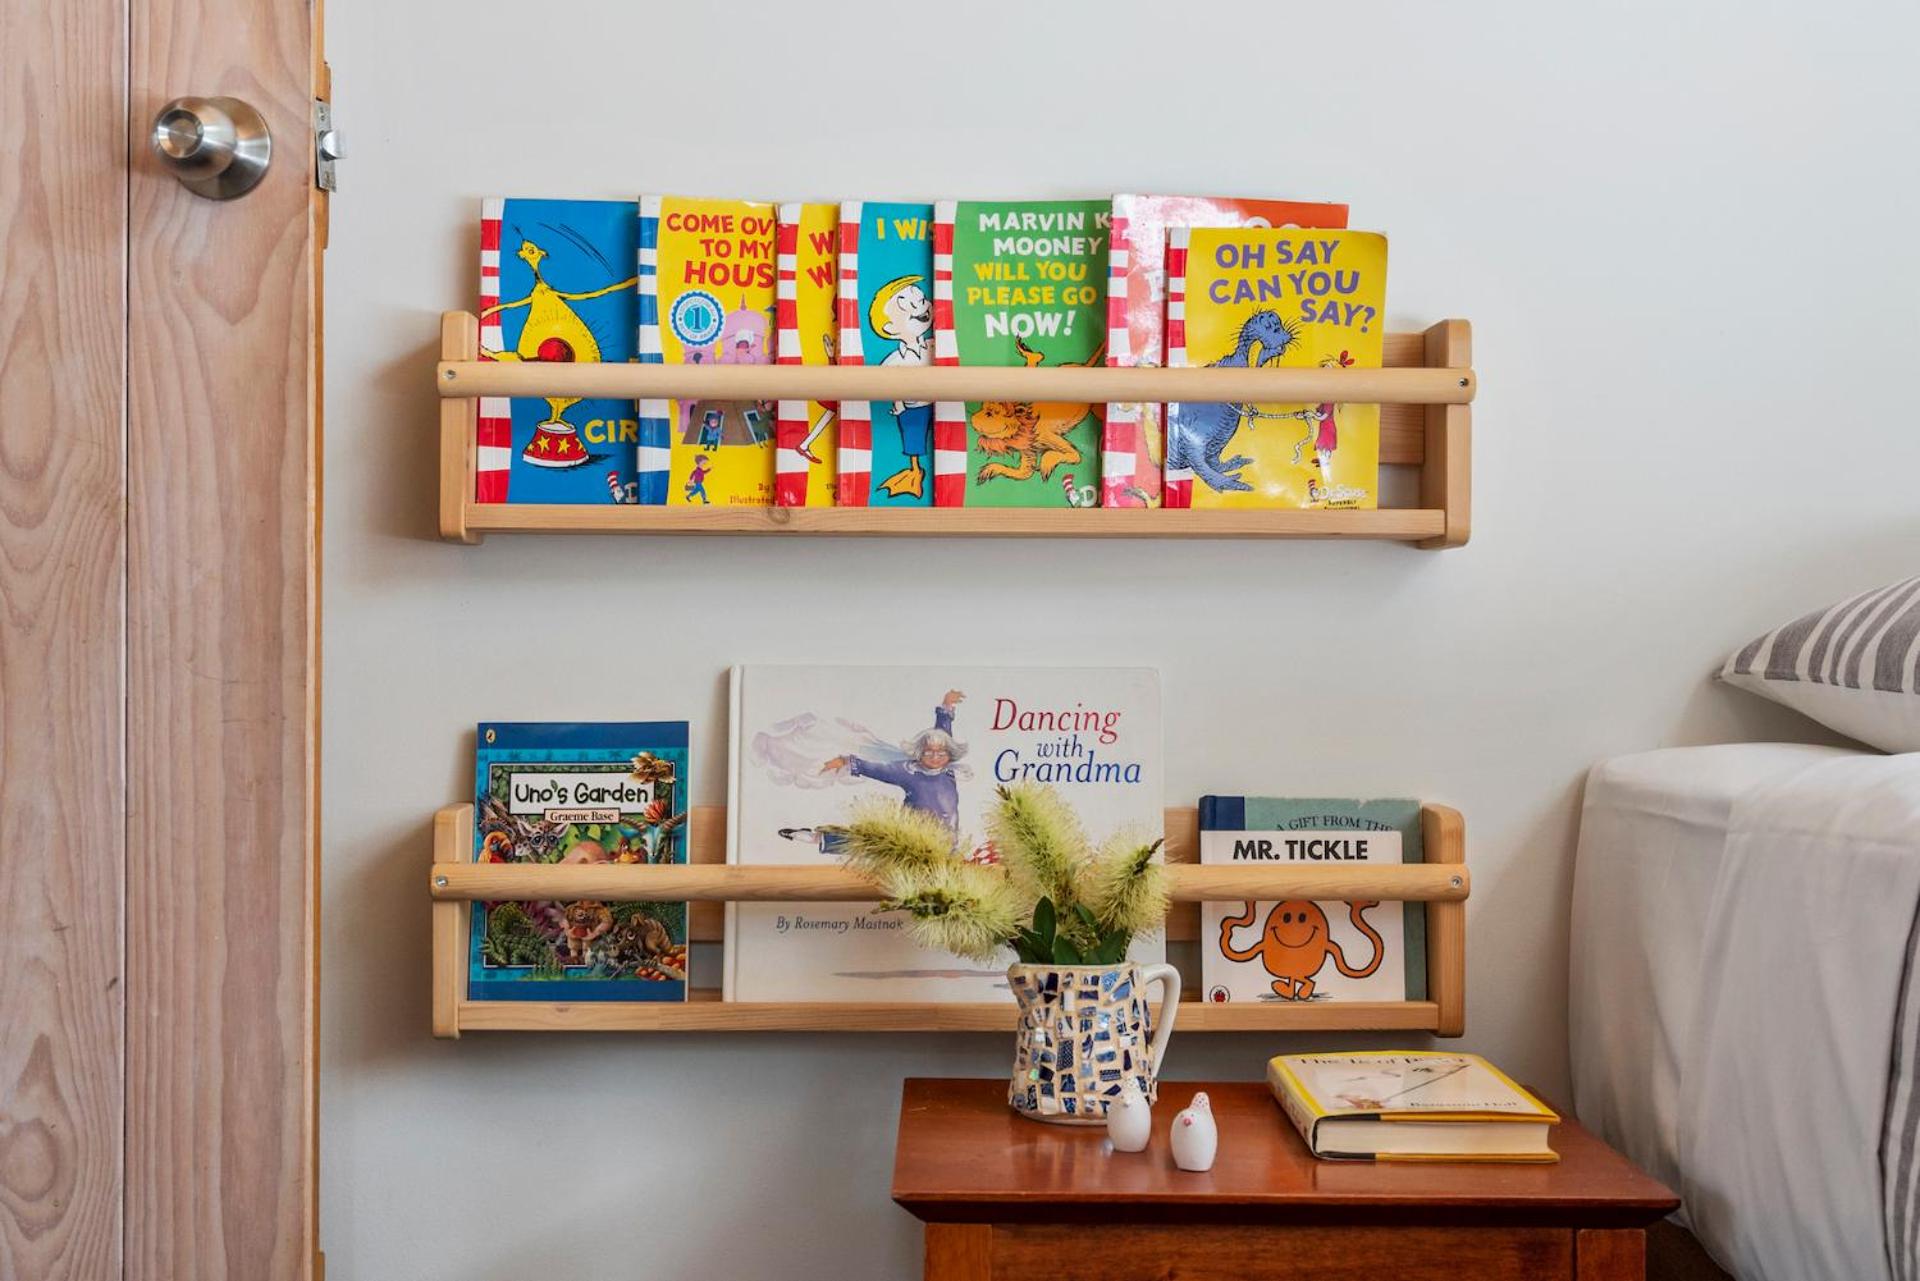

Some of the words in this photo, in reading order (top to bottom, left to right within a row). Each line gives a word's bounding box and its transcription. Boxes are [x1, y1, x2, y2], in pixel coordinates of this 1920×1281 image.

[666, 213, 735, 233] COME
[740, 216, 774, 235] OV
[876, 218, 885, 240] I
[979, 212, 1084, 232] MARVIN
[700, 238, 731, 259] TO
[738, 239, 774, 260] MY
[993, 236, 1103, 257] MOONEY
[1215, 243, 1265, 269] OH
[1275, 240, 1340, 266] SAY
[684, 260, 775, 289] HOUS
[973, 261, 1030, 282] WILL
[1034, 260, 1088, 281] YOU
[966, 286, 1055, 306] PLEASE
[1061, 286, 1098, 306] GO
[1208, 274, 1282, 305] CAN
[1287, 270, 1361, 297] YOU
[984, 310, 1077, 339] NOW!
[1300, 298, 1376, 334] SAY?
[584, 419, 639, 444] CIR
[990, 698, 1121, 745] Dancing
[1037, 733, 1083, 758] with
[994, 748, 1142, 784] Grandma
[514, 779, 568, 805] Uno's
[574, 782, 648, 805] Garden
[549, 811, 588, 823] Graeme
[591, 811, 614, 822] Base
[1288, 815, 1319, 831] GIFT
[1323, 815, 1361, 828] FROM
[1233, 840, 1280, 860] MR.
[1285, 840, 1369, 860] TICKLE
[776, 916, 791, 934] By
[794, 916, 850, 934] Rosemary
